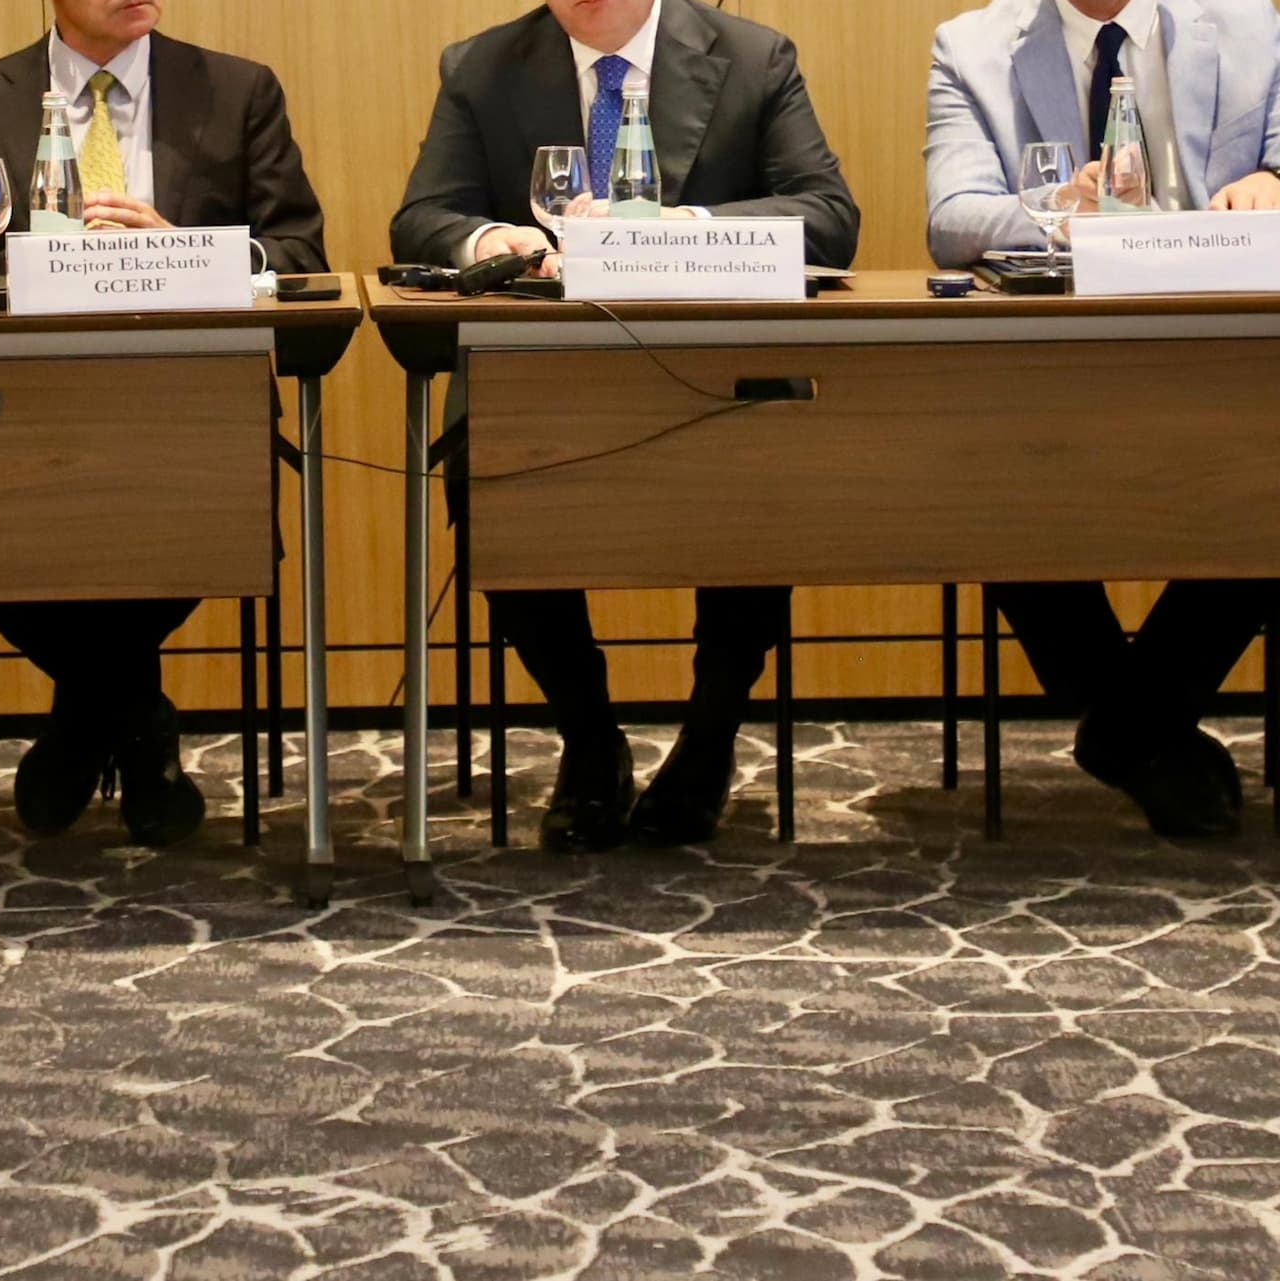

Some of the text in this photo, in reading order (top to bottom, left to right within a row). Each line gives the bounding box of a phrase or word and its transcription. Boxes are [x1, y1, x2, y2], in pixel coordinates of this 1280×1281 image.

[48, 234, 215, 253] Dr. Khalid KOSER
[599, 230, 777, 246] Z. Taulant BALLA
[1122, 232, 1252, 249] Neritan Nallbati
[49, 255, 211, 275] Drejtor Ekzekutiv
[602, 260, 777, 273] Ministër i Brendshëm
[94, 278, 168, 294] GCERF
